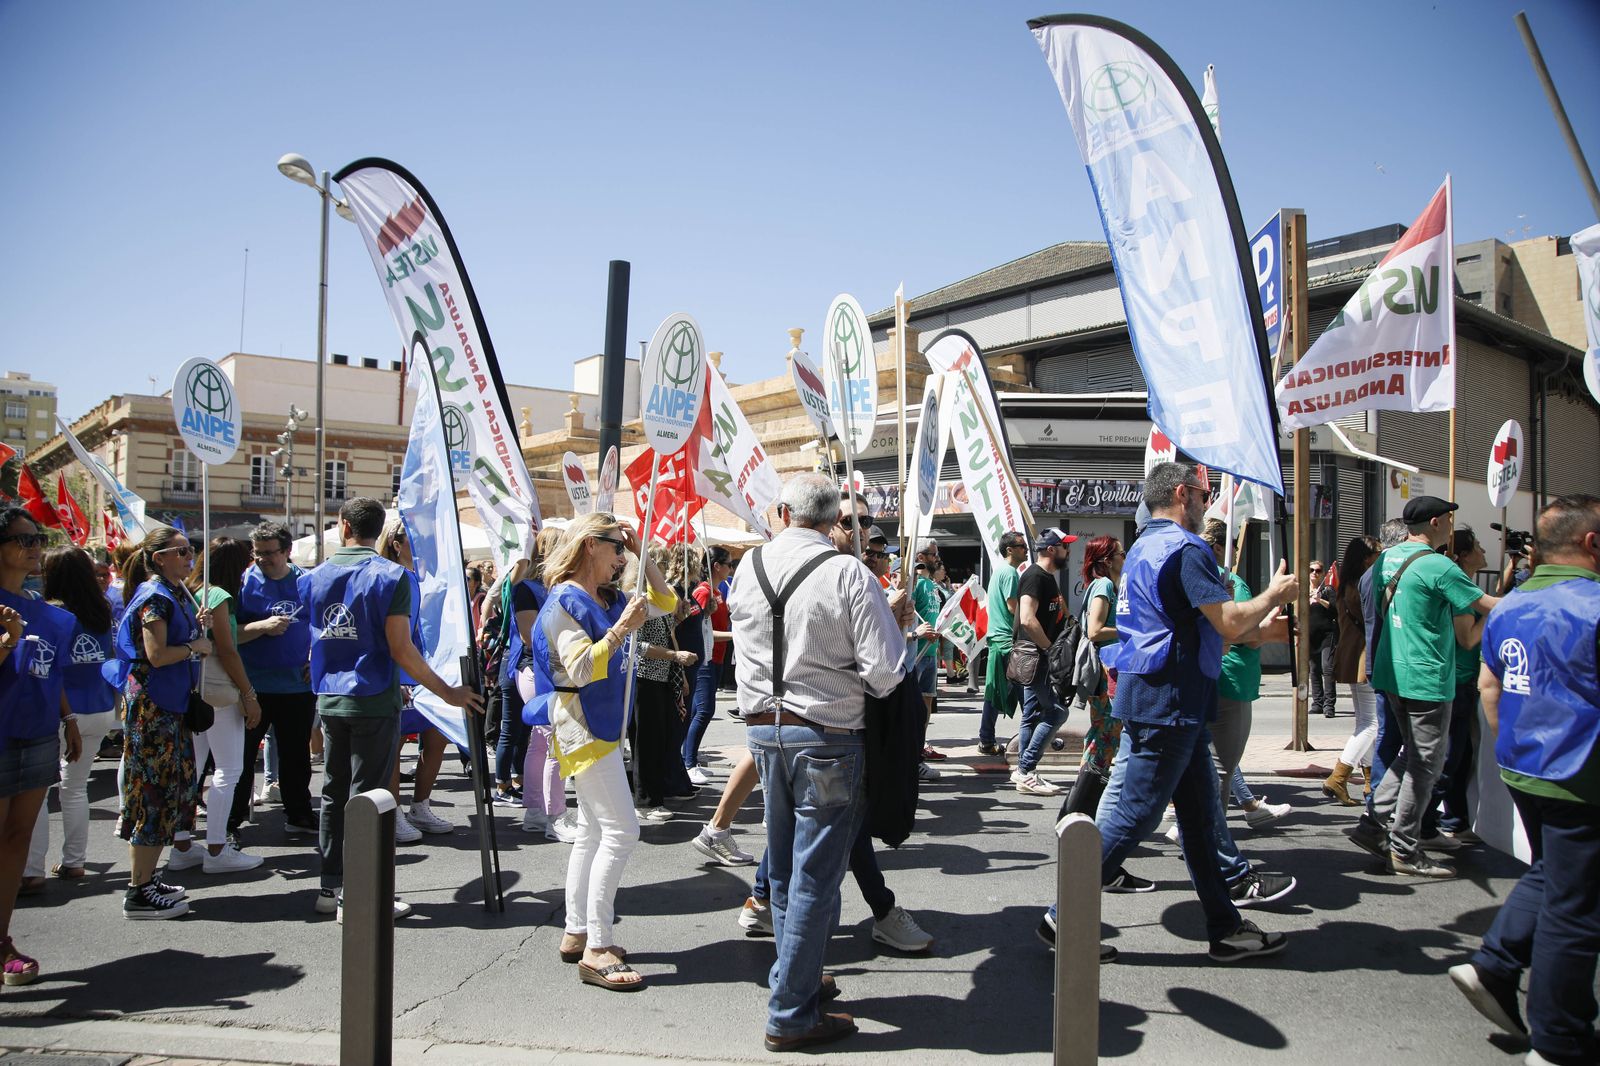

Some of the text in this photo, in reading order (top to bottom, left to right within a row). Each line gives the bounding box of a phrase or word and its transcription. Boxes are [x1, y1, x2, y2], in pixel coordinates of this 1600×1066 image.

[646, 383, 697, 422] ANPE
[181, 406, 236, 444] ANPE
[1099, 435, 1149, 443] THE PREMIUM
[450, 449, 471, 470] PE
[1492, 462, 1517, 489] USTEA
[571, 486, 590, 500] USTEA
[1066, 484, 1145, 507] El Sevillan
[1116, 599, 1131, 612] PE
[321, 626, 358, 638] ANPE
